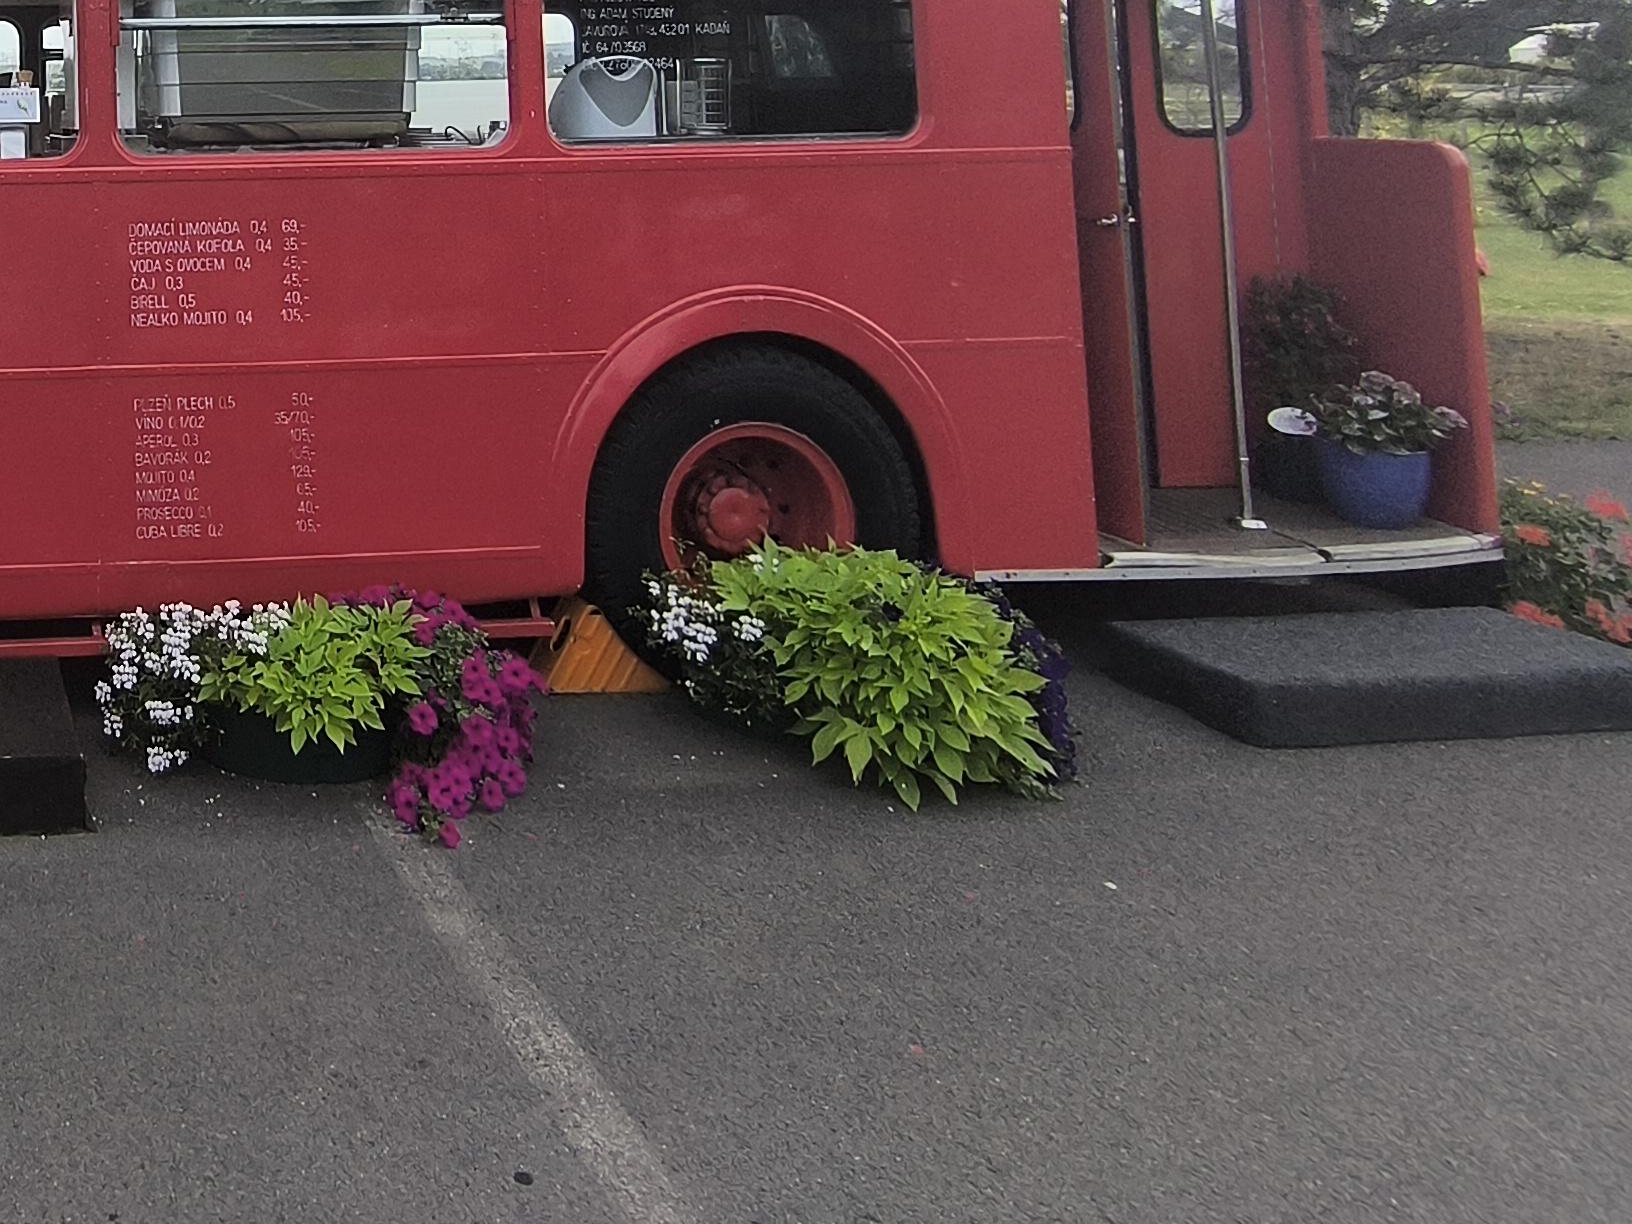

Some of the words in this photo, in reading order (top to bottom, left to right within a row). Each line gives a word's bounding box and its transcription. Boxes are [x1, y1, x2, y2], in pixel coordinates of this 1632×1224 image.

[178, 216, 241, 236] LIMONÁDA
[197, 239, 244, 253] KOFOLA
[130, 258, 161, 274] VODA
[177, 257, 225, 272] OVOCEM
[130, 294, 169, 310] BIRELL
[130, 311, 178, 327] NEALKO
[183, 310, 227, 326] MOJITO
[176, 396, 214, 412] PLECH
[135, 413, 164, 430] VÍNO
[136, 506, 193, 522] PROSECCO
[136, 524, 167, 540] CUBA
[170, 523, 202, 539] LIBRE
